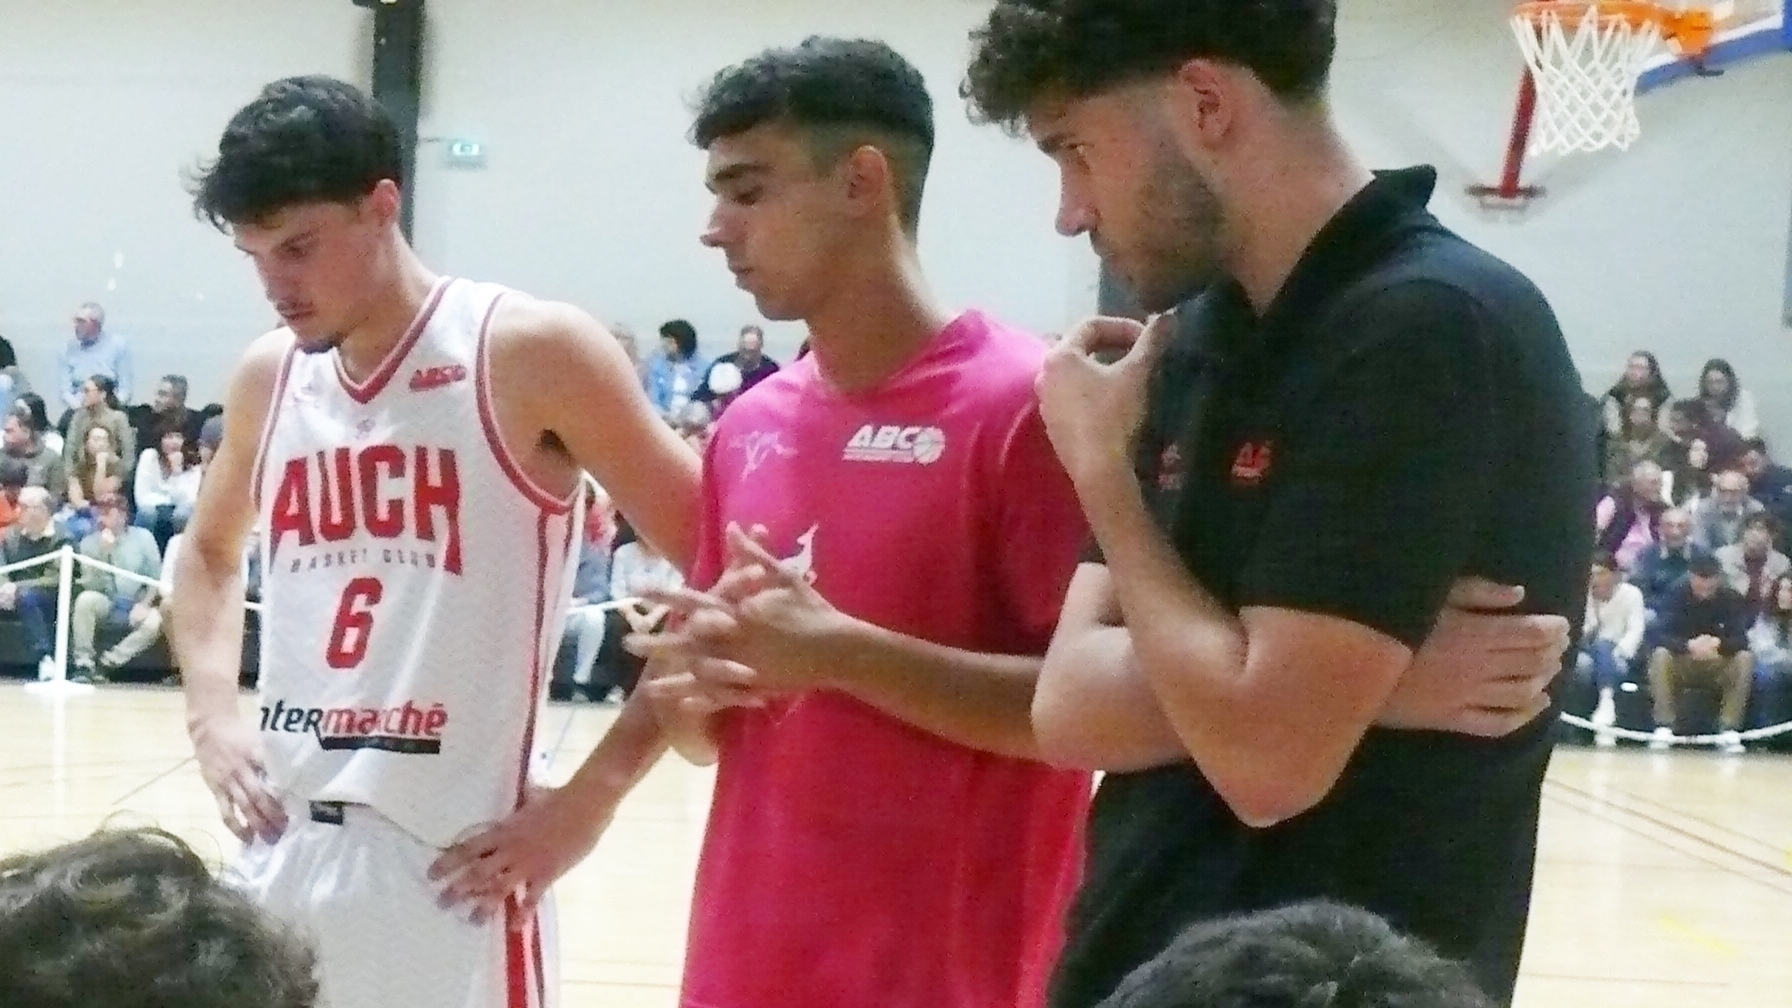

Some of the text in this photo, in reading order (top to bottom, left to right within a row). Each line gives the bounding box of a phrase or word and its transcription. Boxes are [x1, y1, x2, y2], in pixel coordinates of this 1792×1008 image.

[844, 424, 920, 450] ABC
[269, 445, 462, 576] AUCH
[290, 549, 436, 573] BASKET CLUB
[326, 577, 383, 669] 6
